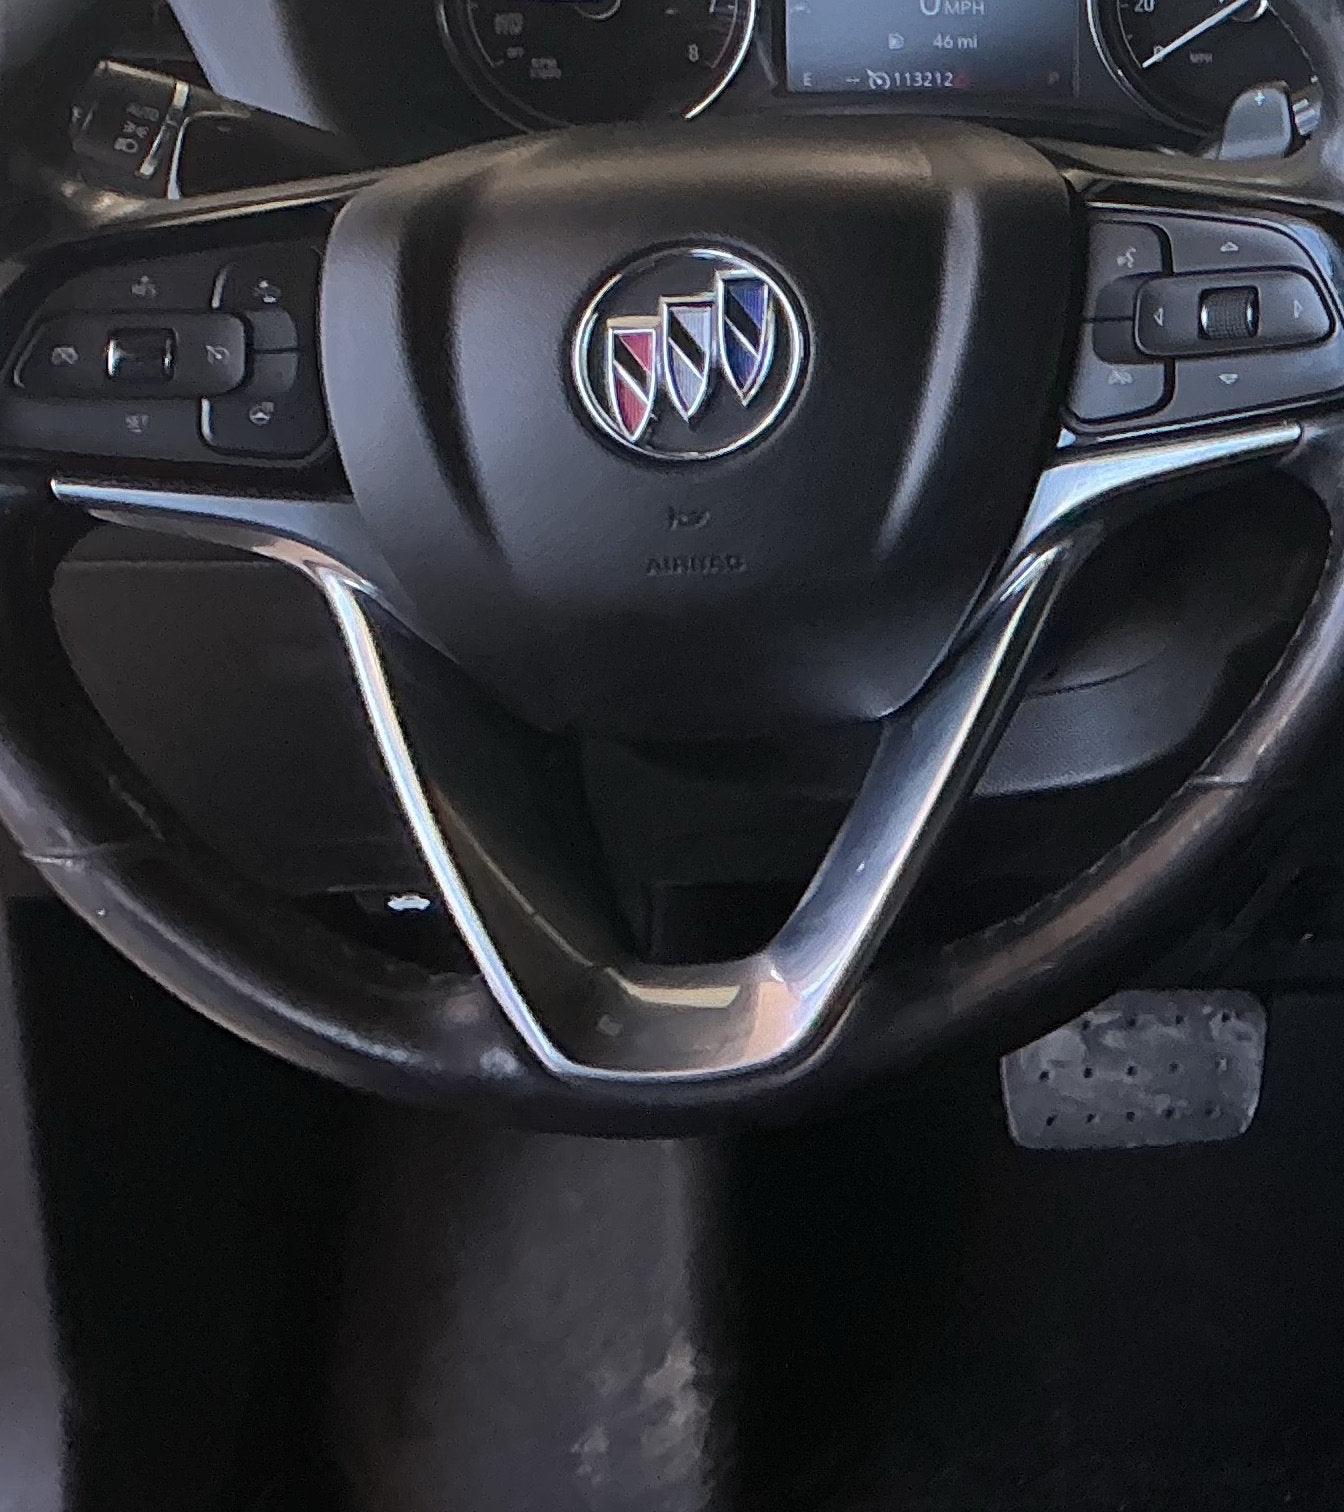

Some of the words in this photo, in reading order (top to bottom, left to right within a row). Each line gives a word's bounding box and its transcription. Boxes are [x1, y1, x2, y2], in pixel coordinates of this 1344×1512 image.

[944, 0, 985, 15] MPH
[933, 34, 954, 49] 46
[957, 34, 978, 49] mi
[688, 44, 699, 62] 8
[803, 72, 811, 86] E
[894, 71, 954, 87] 113212
